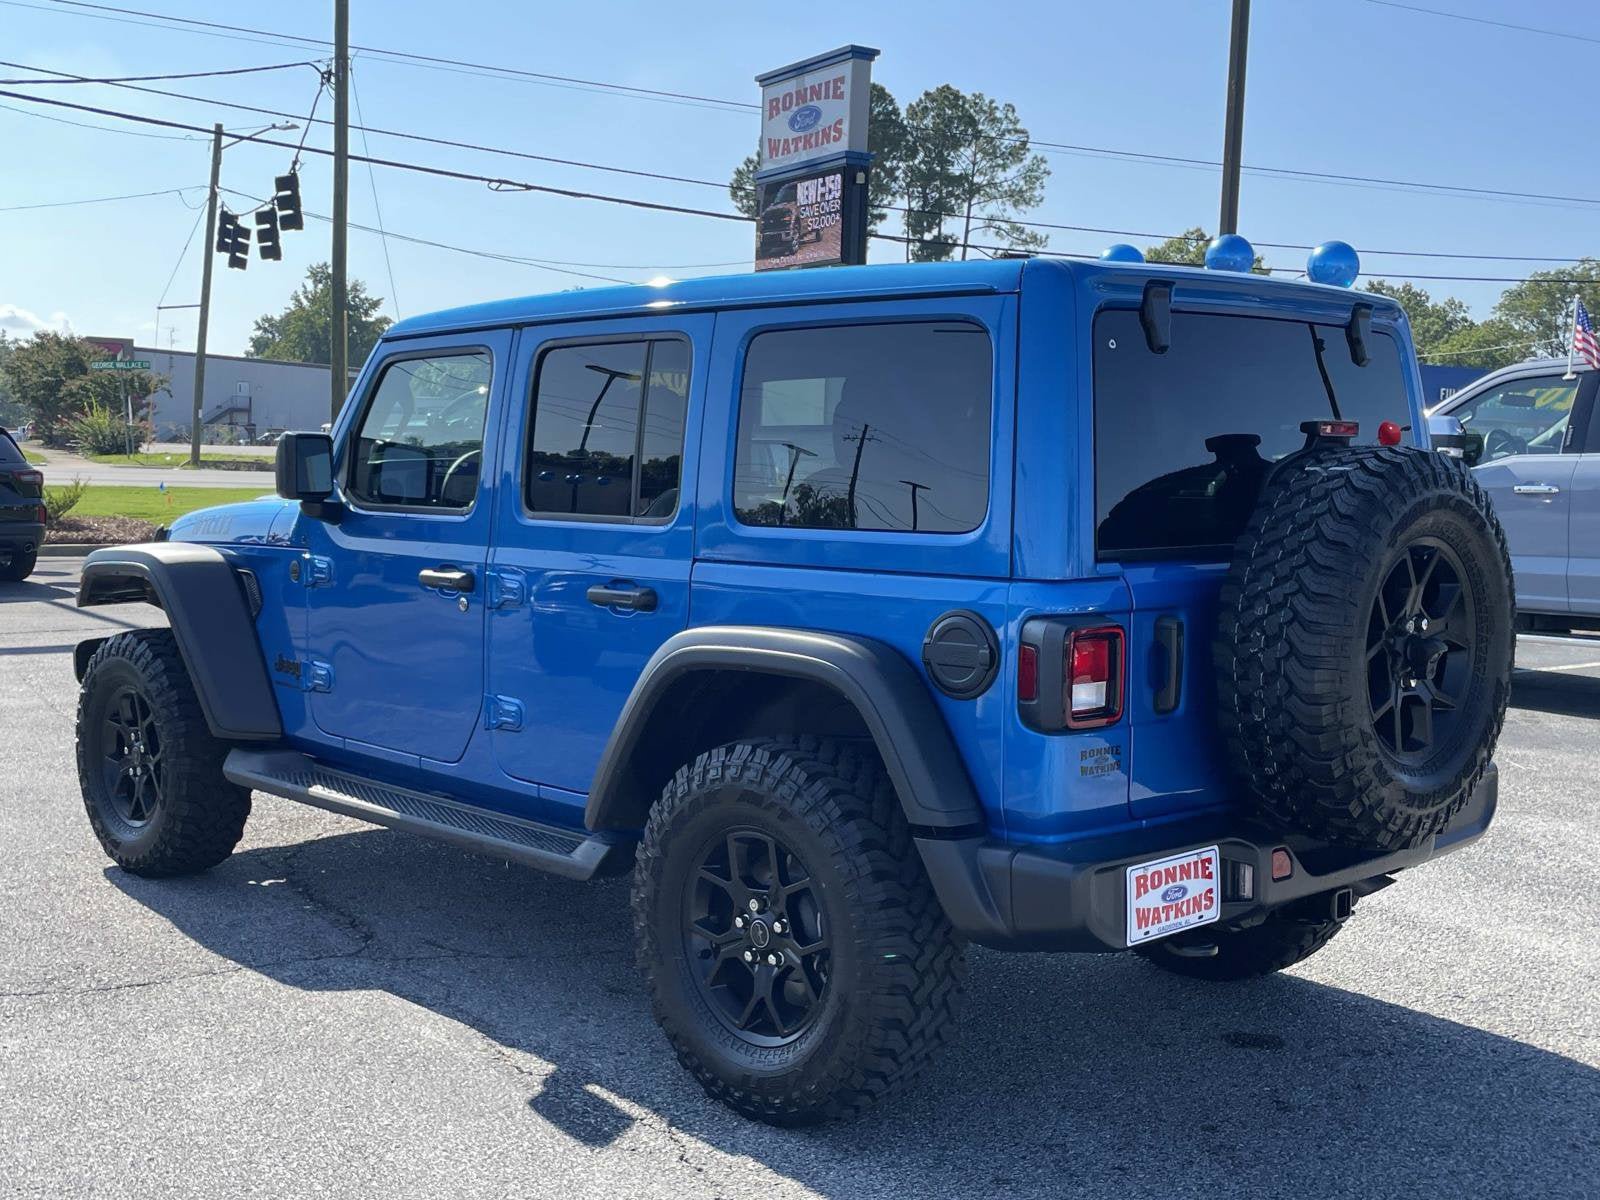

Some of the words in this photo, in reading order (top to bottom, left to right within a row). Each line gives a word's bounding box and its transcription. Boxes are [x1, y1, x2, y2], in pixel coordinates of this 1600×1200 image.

[768, 76, 845, 121] RONNIE
[791, 108, 819, 130] Ford
[767, 118, 844, 159] WATKINS
[797, 179, 818, 206] NEW
[800, 204, 820, 218] SAVE
[820, 199, 840, 214] OVER
[91, 361, 114, 369] GEORGE
[116, 361, 143, 369] WALLACE
[1081, 745, 1121, 761] RONNIE
[1081, 760, 1121, 776] WATKINS
[1136, 857, 1213, 900] RONNIE
[1165, 886, 1184, 901] Ford
[1136, 888, 1214, 930] WATKINS
